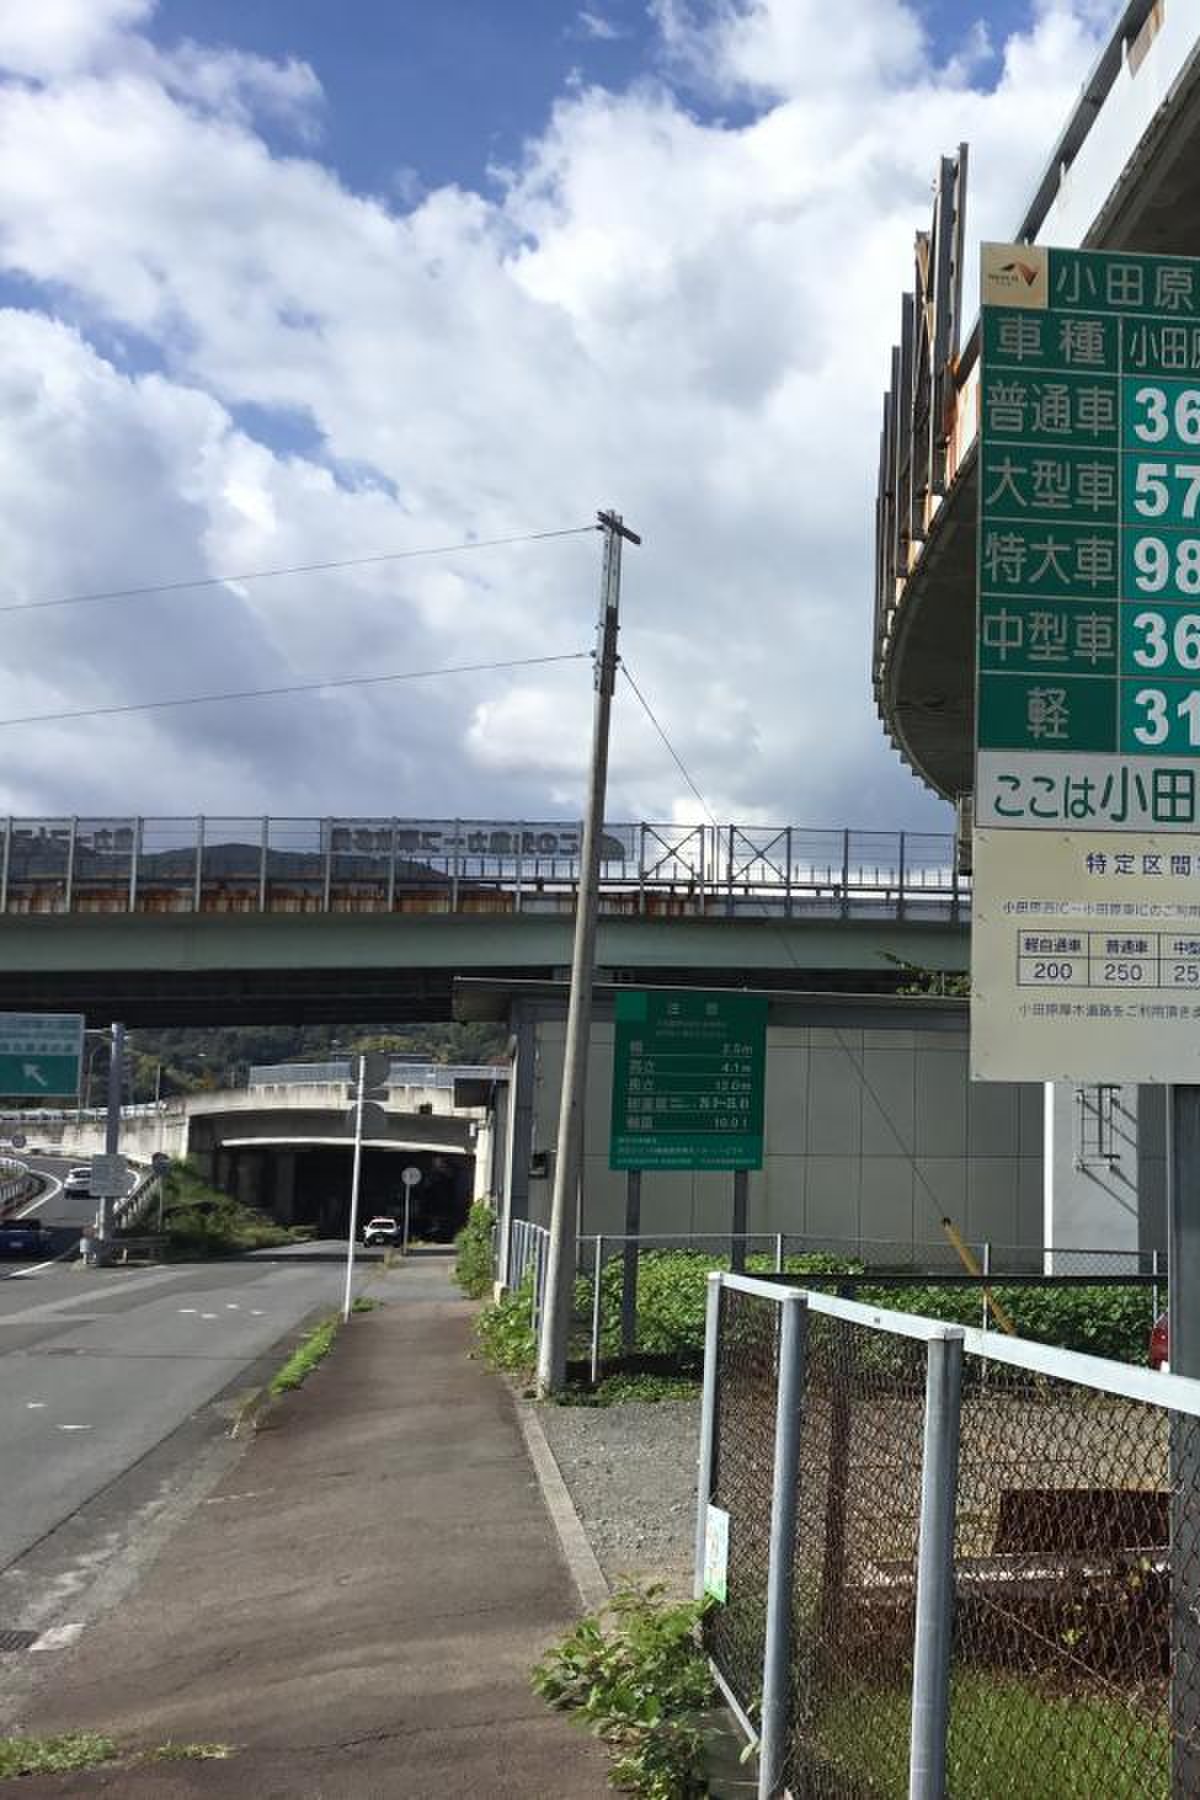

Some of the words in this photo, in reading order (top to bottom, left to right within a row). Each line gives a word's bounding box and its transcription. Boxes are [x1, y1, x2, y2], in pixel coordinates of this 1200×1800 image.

[997, 317, 1105, 366] 車種
[987, 383, 1118, 437] 普通車
[987, 456, 1116, 512] 大型車
[984, 531, 1116, 588] 特大車
[983, 608, 1115, 665] 中型車
[1026, 686, 1069, 739] 軽
[1033, 962, 1073, 980] 200
[1104, 963, 1143, 982] 250
